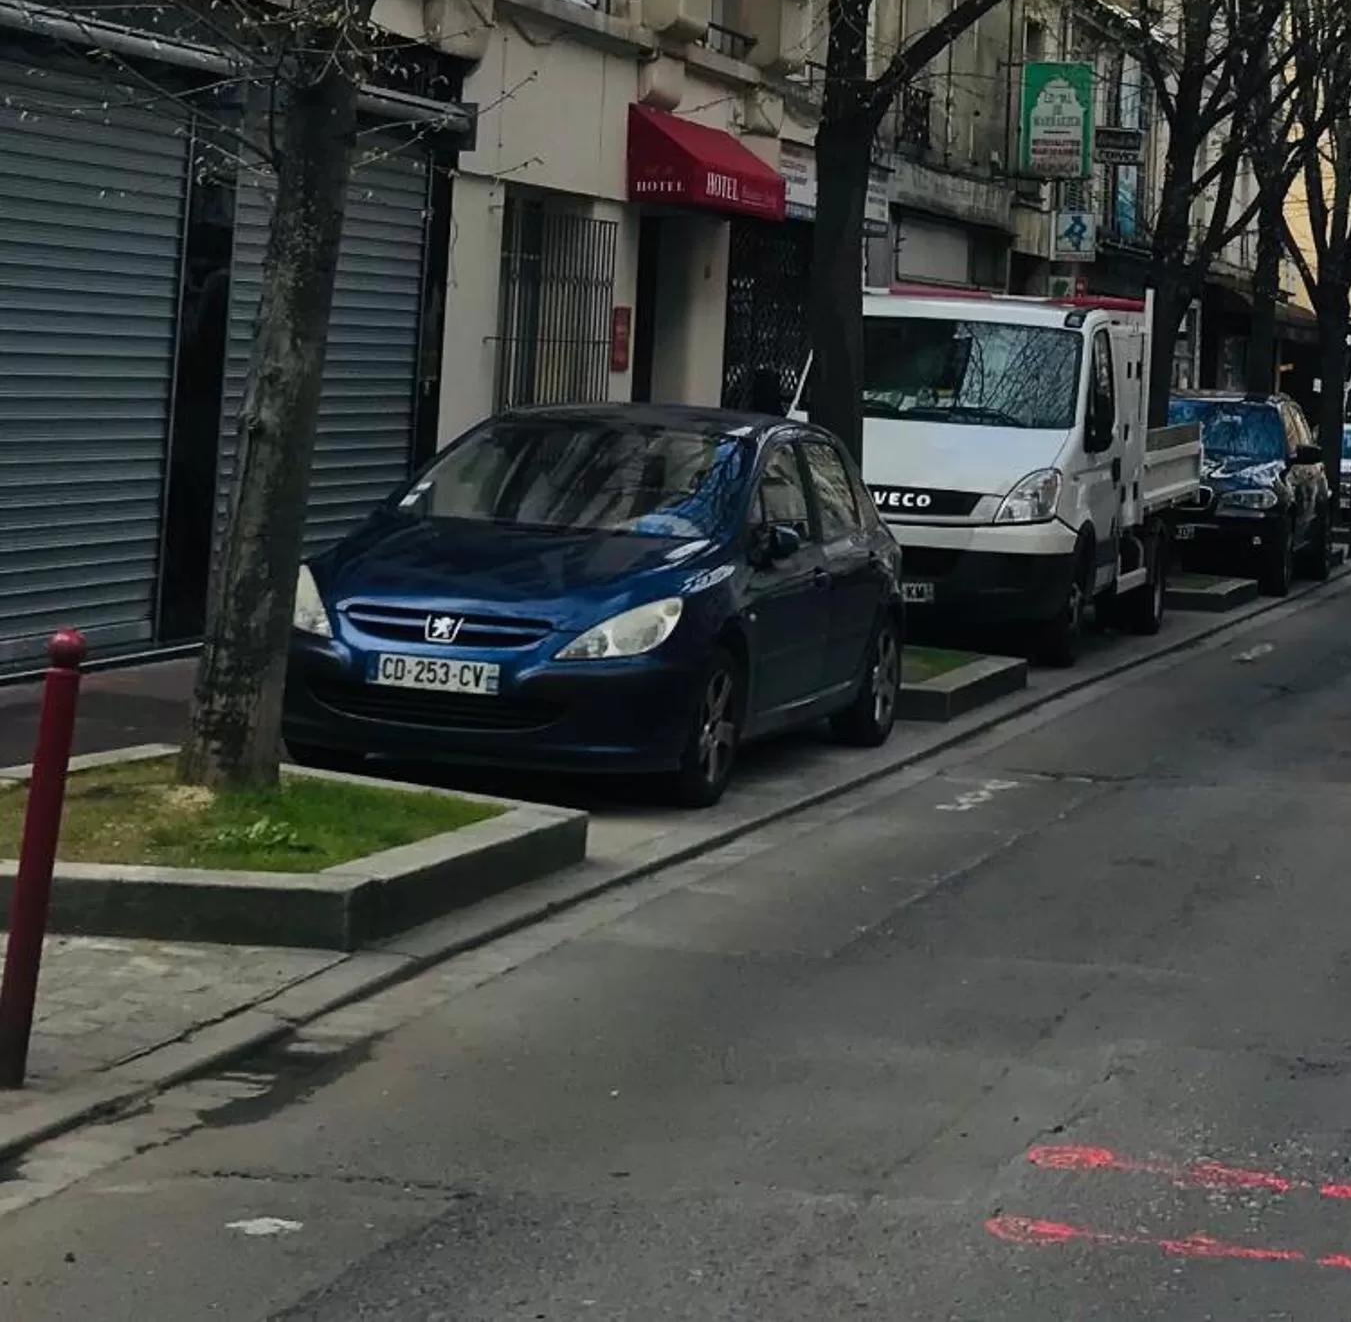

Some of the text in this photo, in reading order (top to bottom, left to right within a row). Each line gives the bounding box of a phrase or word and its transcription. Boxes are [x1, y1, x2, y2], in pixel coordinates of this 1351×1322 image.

[636, 180, 686, 193] HOTEL
[705, 171, 740, 201] HOTEL
[873, 491, 932, 508] VECO
